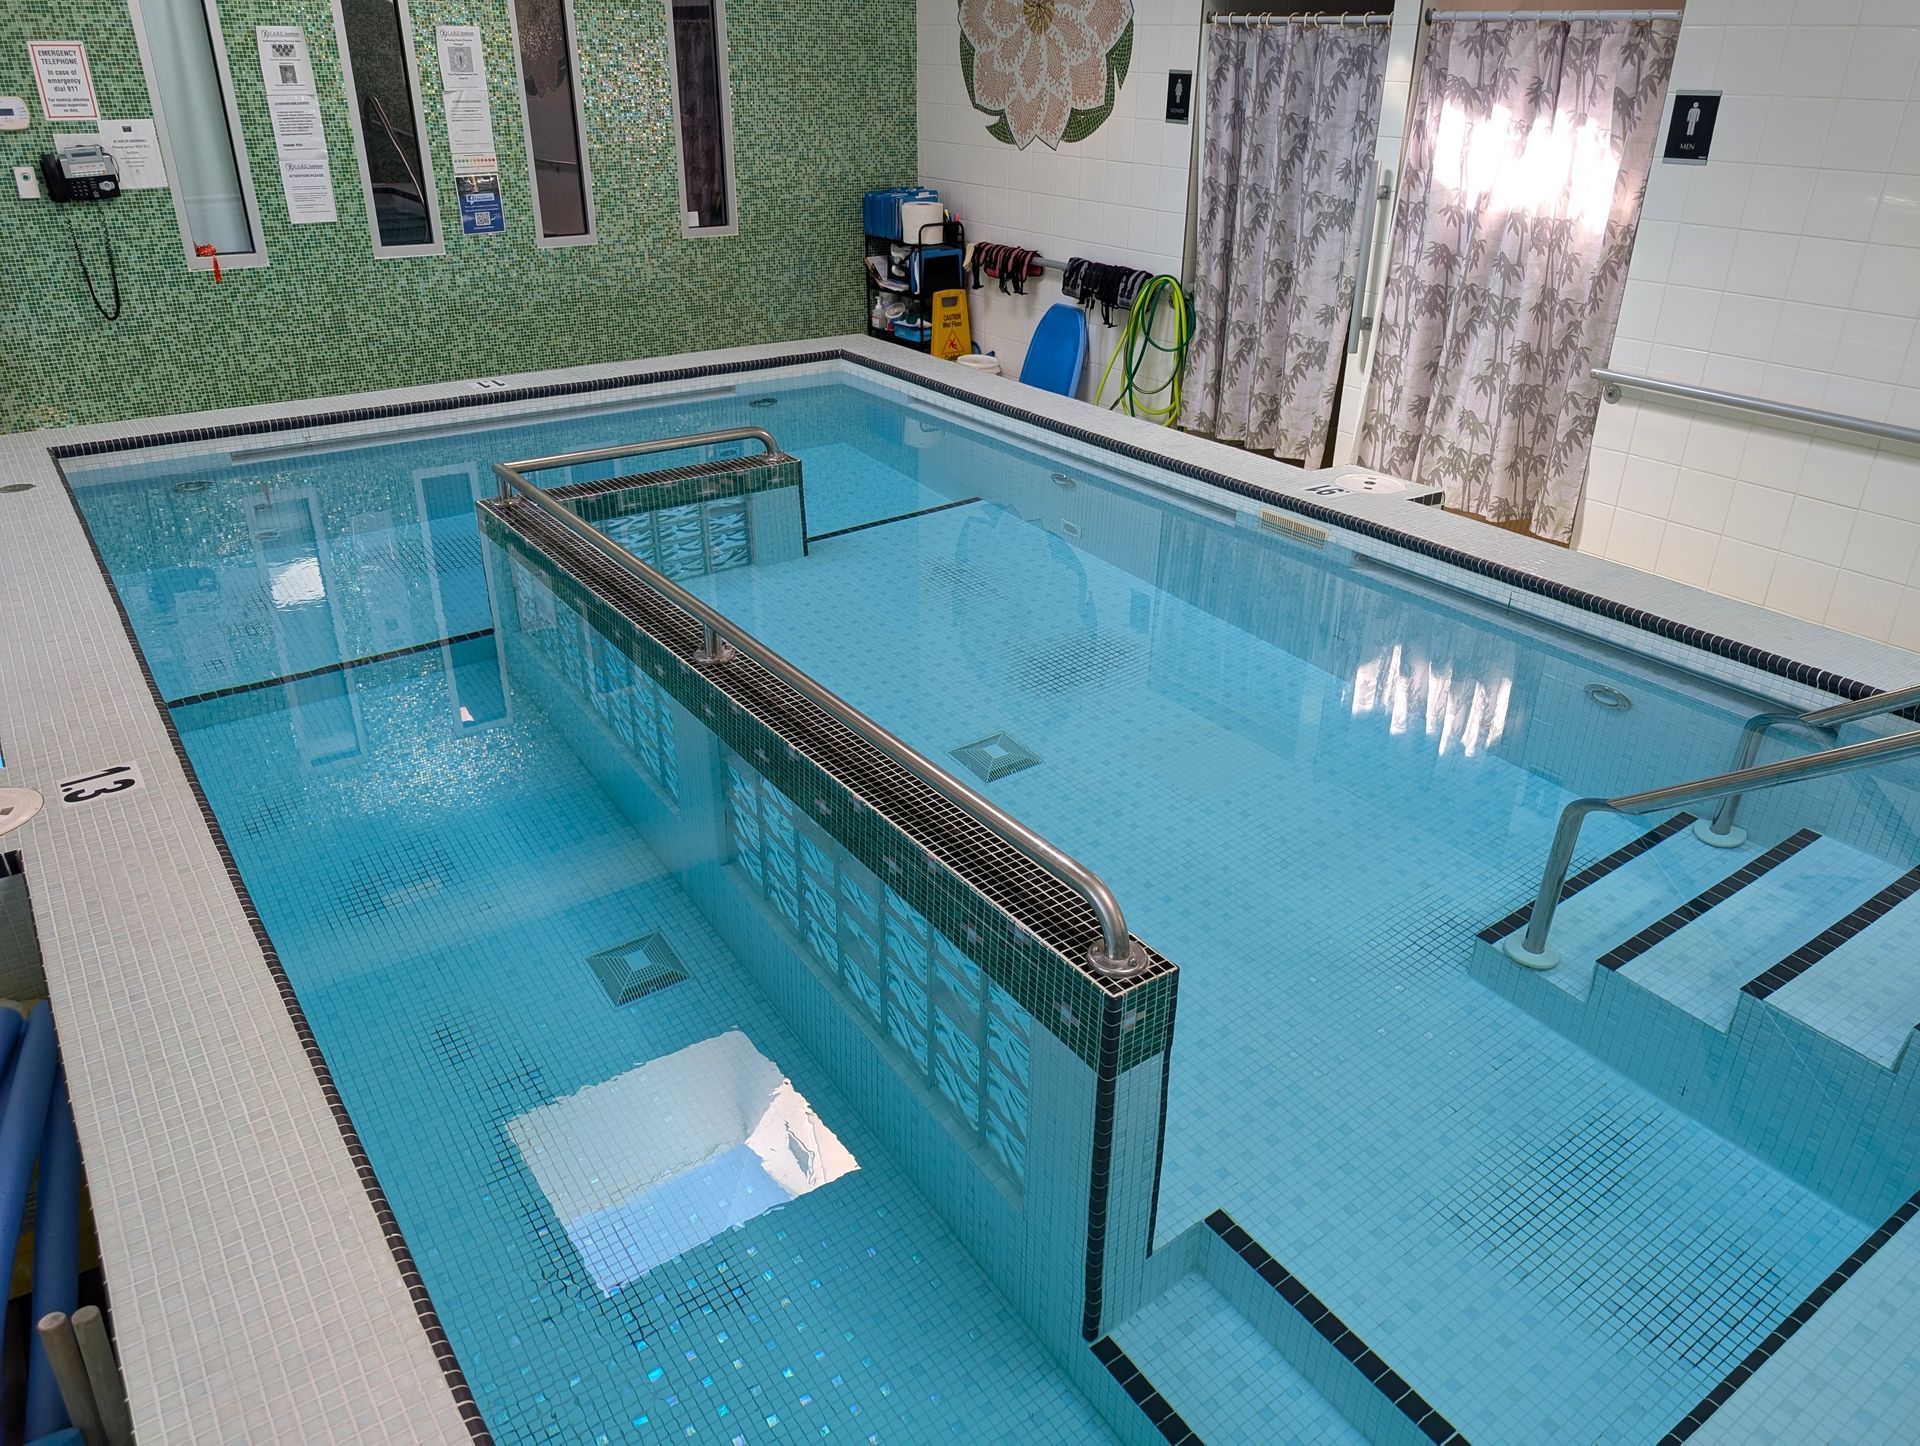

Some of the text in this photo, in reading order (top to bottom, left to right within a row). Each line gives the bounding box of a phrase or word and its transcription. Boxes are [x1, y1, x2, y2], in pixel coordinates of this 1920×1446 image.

[37, 49, 77, 57] EMERGENCY
[944, 313, 961, 321] CAUTION
[951, 320, 962, 328] Floor
[60, 766, 136, 803] 1.3
